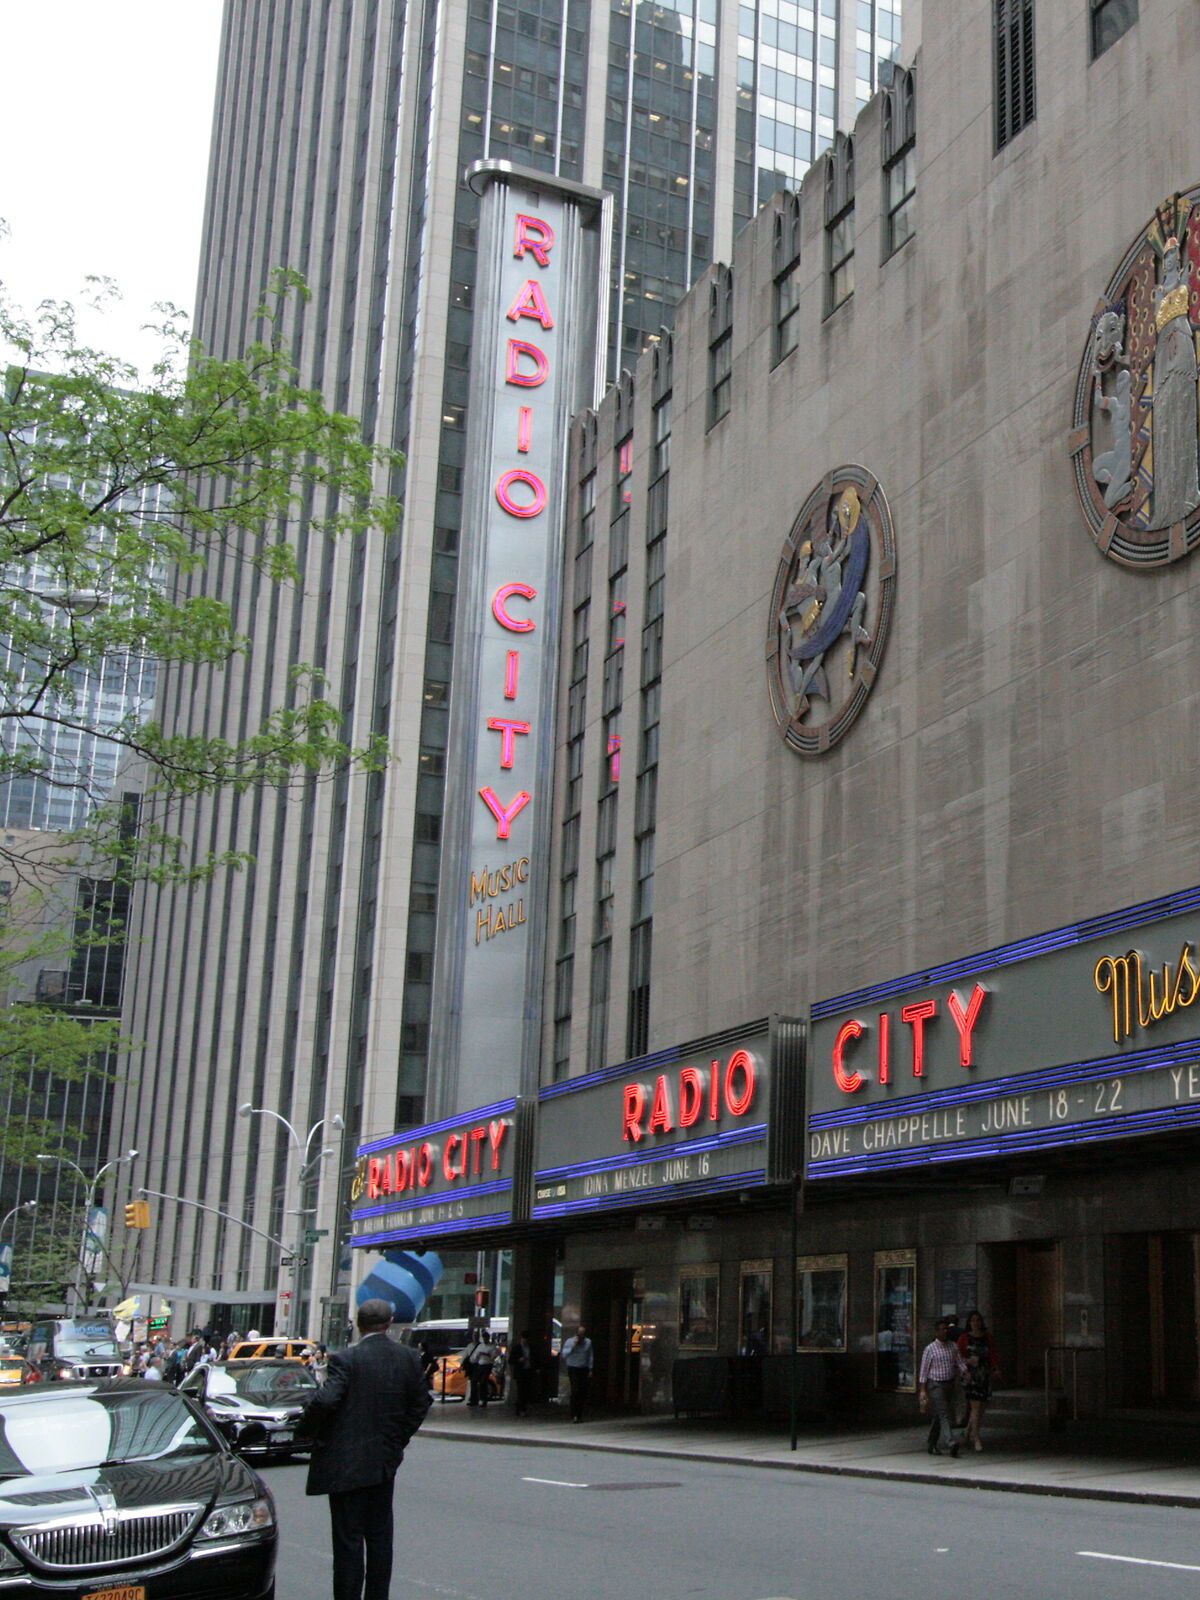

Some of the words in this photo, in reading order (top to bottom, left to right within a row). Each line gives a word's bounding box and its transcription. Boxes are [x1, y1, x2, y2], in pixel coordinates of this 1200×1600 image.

[495, 213, 555, 518] RADIO
[479, 582, 538, 840] CITY
[469, 857, 529, 908] MUSIC
[476, 899, 528, 946] HALL
[833, 982, 989, 1093] CITY
[622, 1049, 757, 1142] RADIO
[811, 1131, 850, 1159] DAVE
[863, 1107, 965, 1150] CHAPPELLE
[981, 1096, 1032, 1131] JUNE
[368, 1142, 433, 1199] RADIO
[443, 1119, 509, 1181] CITY
[662, 1158, 691, 1183] JUNE
[698, 1153, 710, 1176] 16
